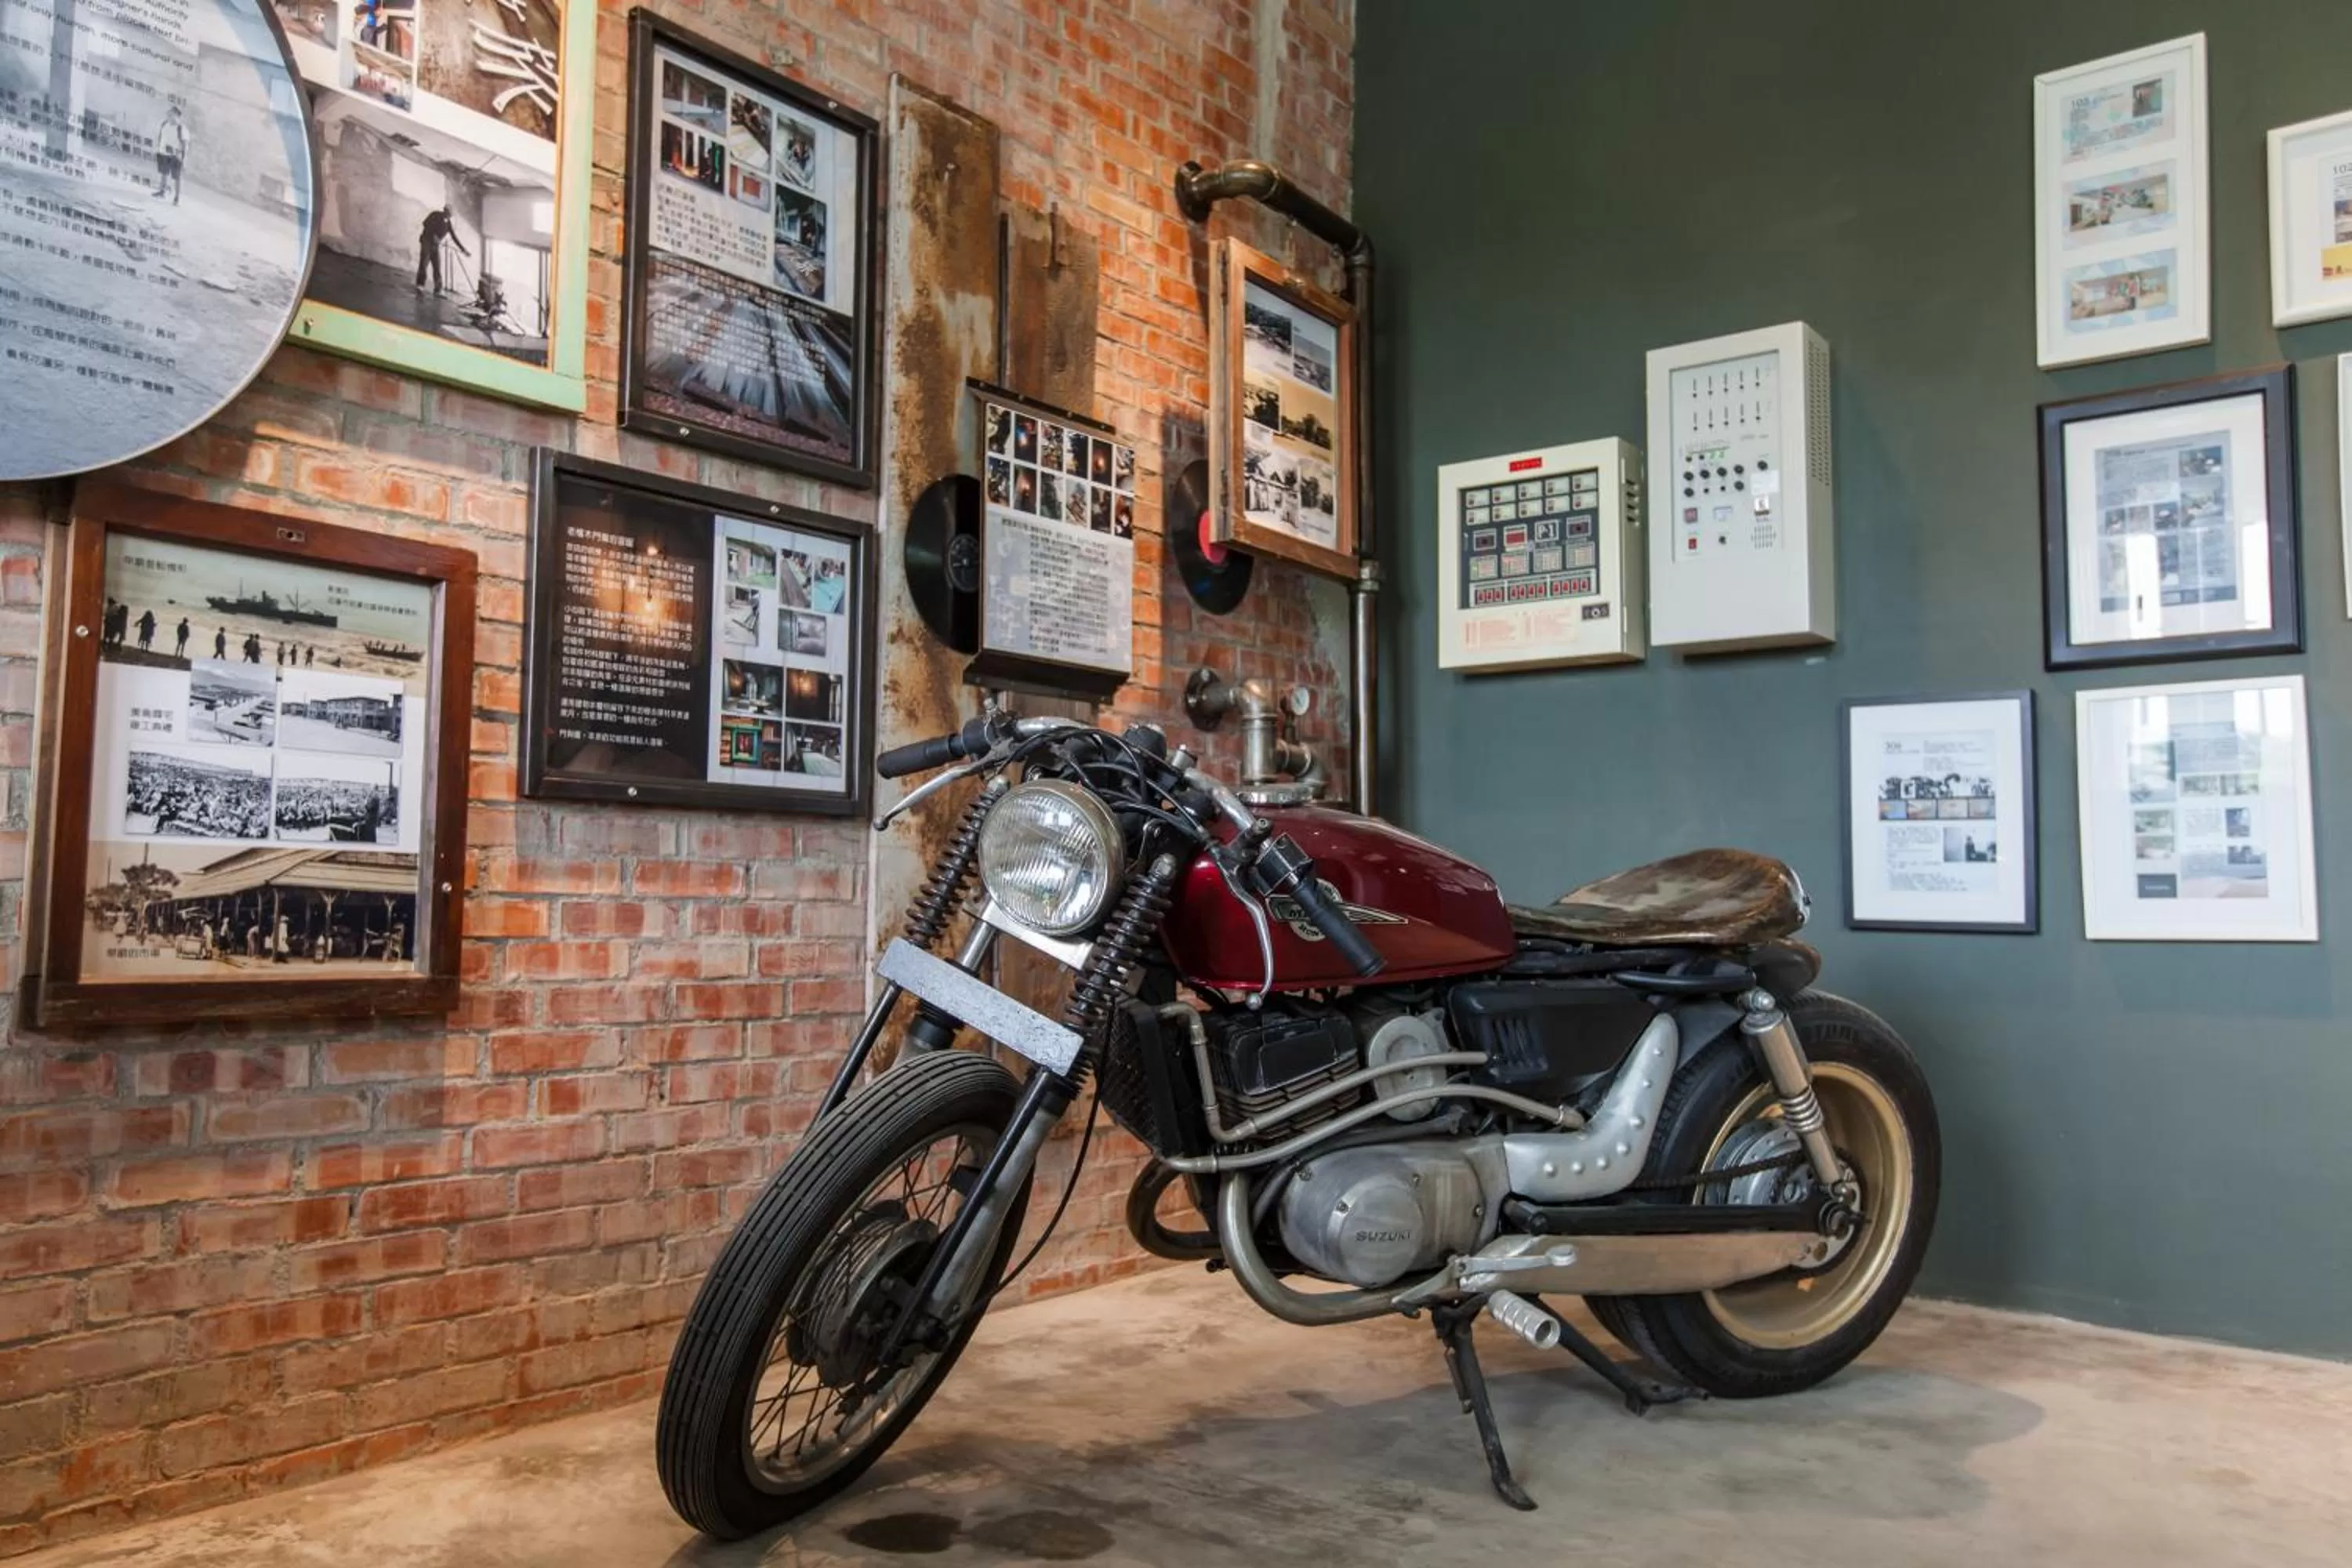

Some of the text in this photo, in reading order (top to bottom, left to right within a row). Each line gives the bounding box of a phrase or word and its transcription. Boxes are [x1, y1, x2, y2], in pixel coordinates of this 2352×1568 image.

[100, 31, 129, 48] more
[130, 42, 171, 63] cultural
[172, 58, 194, 71] and
[1355, 1229, 1410, 1242] SUZUKI
